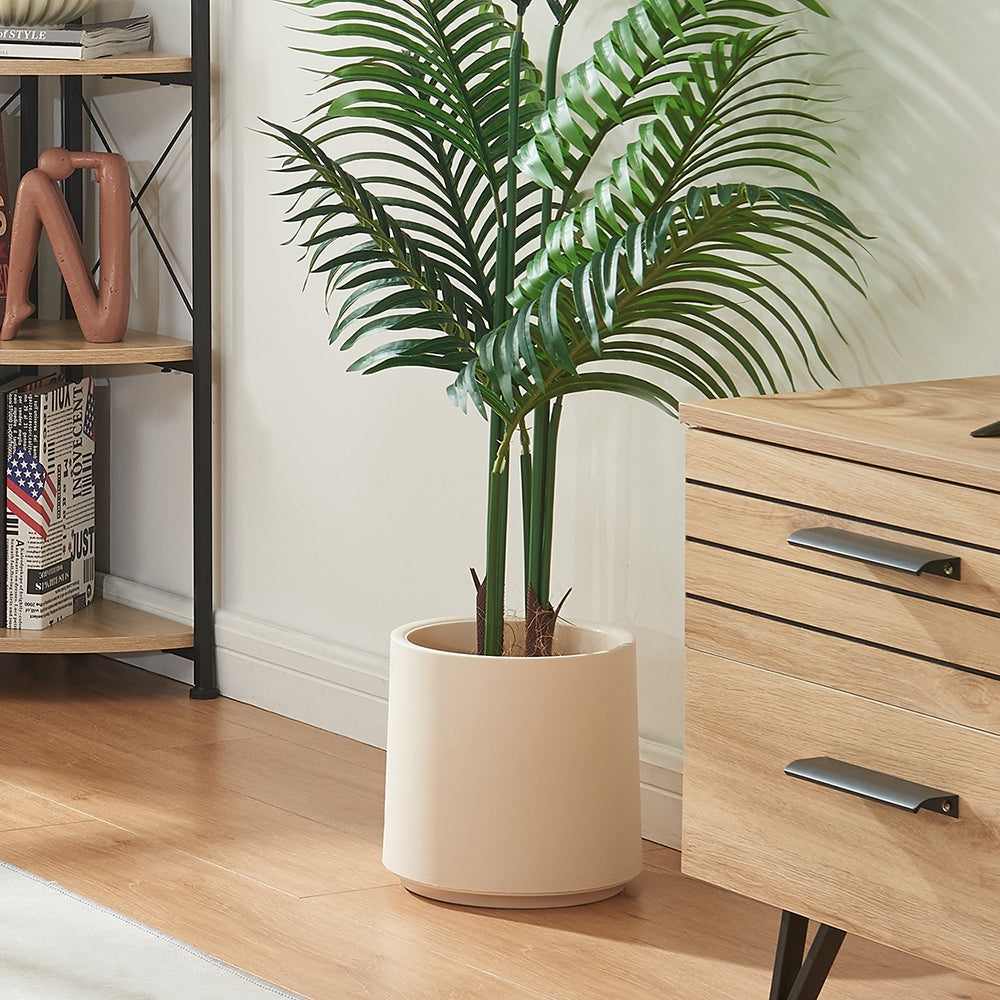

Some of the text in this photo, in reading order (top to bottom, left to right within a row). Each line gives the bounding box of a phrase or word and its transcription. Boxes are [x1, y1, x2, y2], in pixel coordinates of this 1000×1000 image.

[9, 30, 47, 40] STYLE
[72, 386, 84, 498] INOVECENT
[71, 526, 96, 562] JUST
